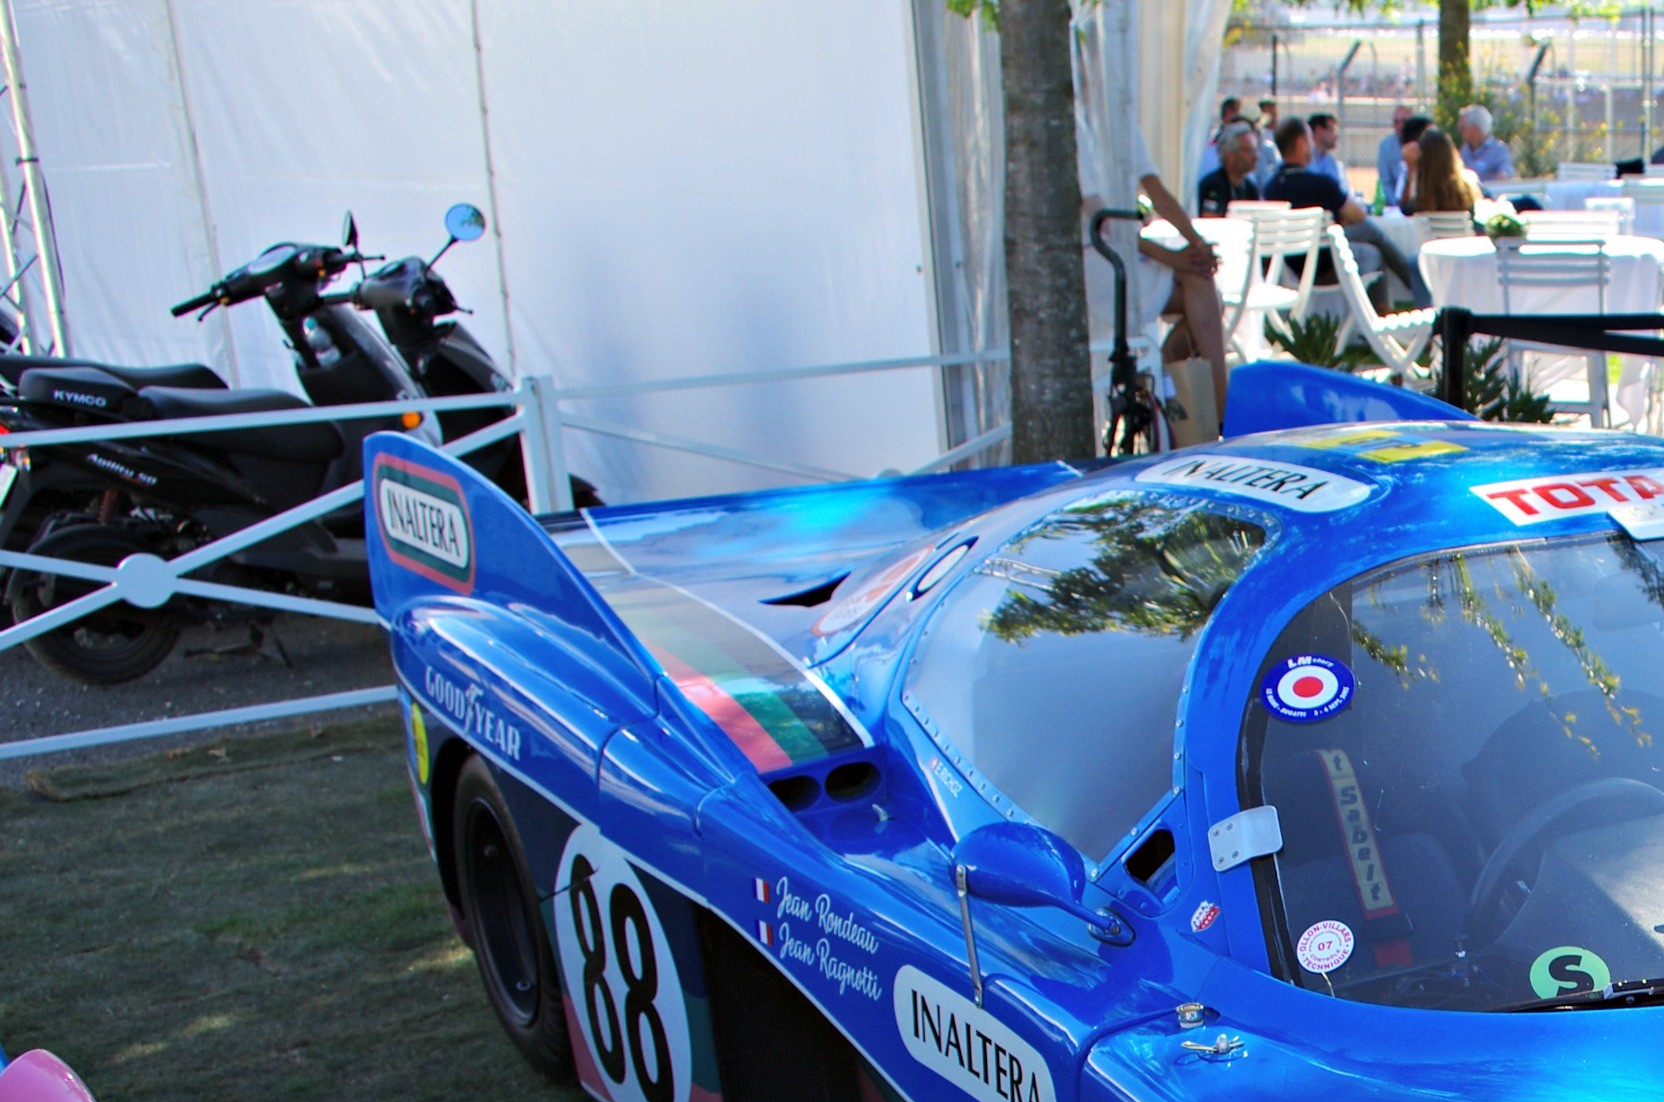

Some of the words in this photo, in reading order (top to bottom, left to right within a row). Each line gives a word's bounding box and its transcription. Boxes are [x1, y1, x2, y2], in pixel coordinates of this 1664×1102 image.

[53, 389, 108, 409] KYMCO
[1161, 458, 1330, 500] INALTERA
[386, 487, 461, 558] INALTERA
[776, 876, 813, 921] Jean
[814, 893, 880, 954] Rondeau
[1299, 922, 1352, 952] OLLON-VILLARS
[1317, 940, 1333, 952] 07
[779, 922, 815, 966] Jean
[816, 938, 883, 1001] Ragnotti
[1303, 949, 1350, 970] TECHNIQUE
[1548, 954, 1595, 997] S
